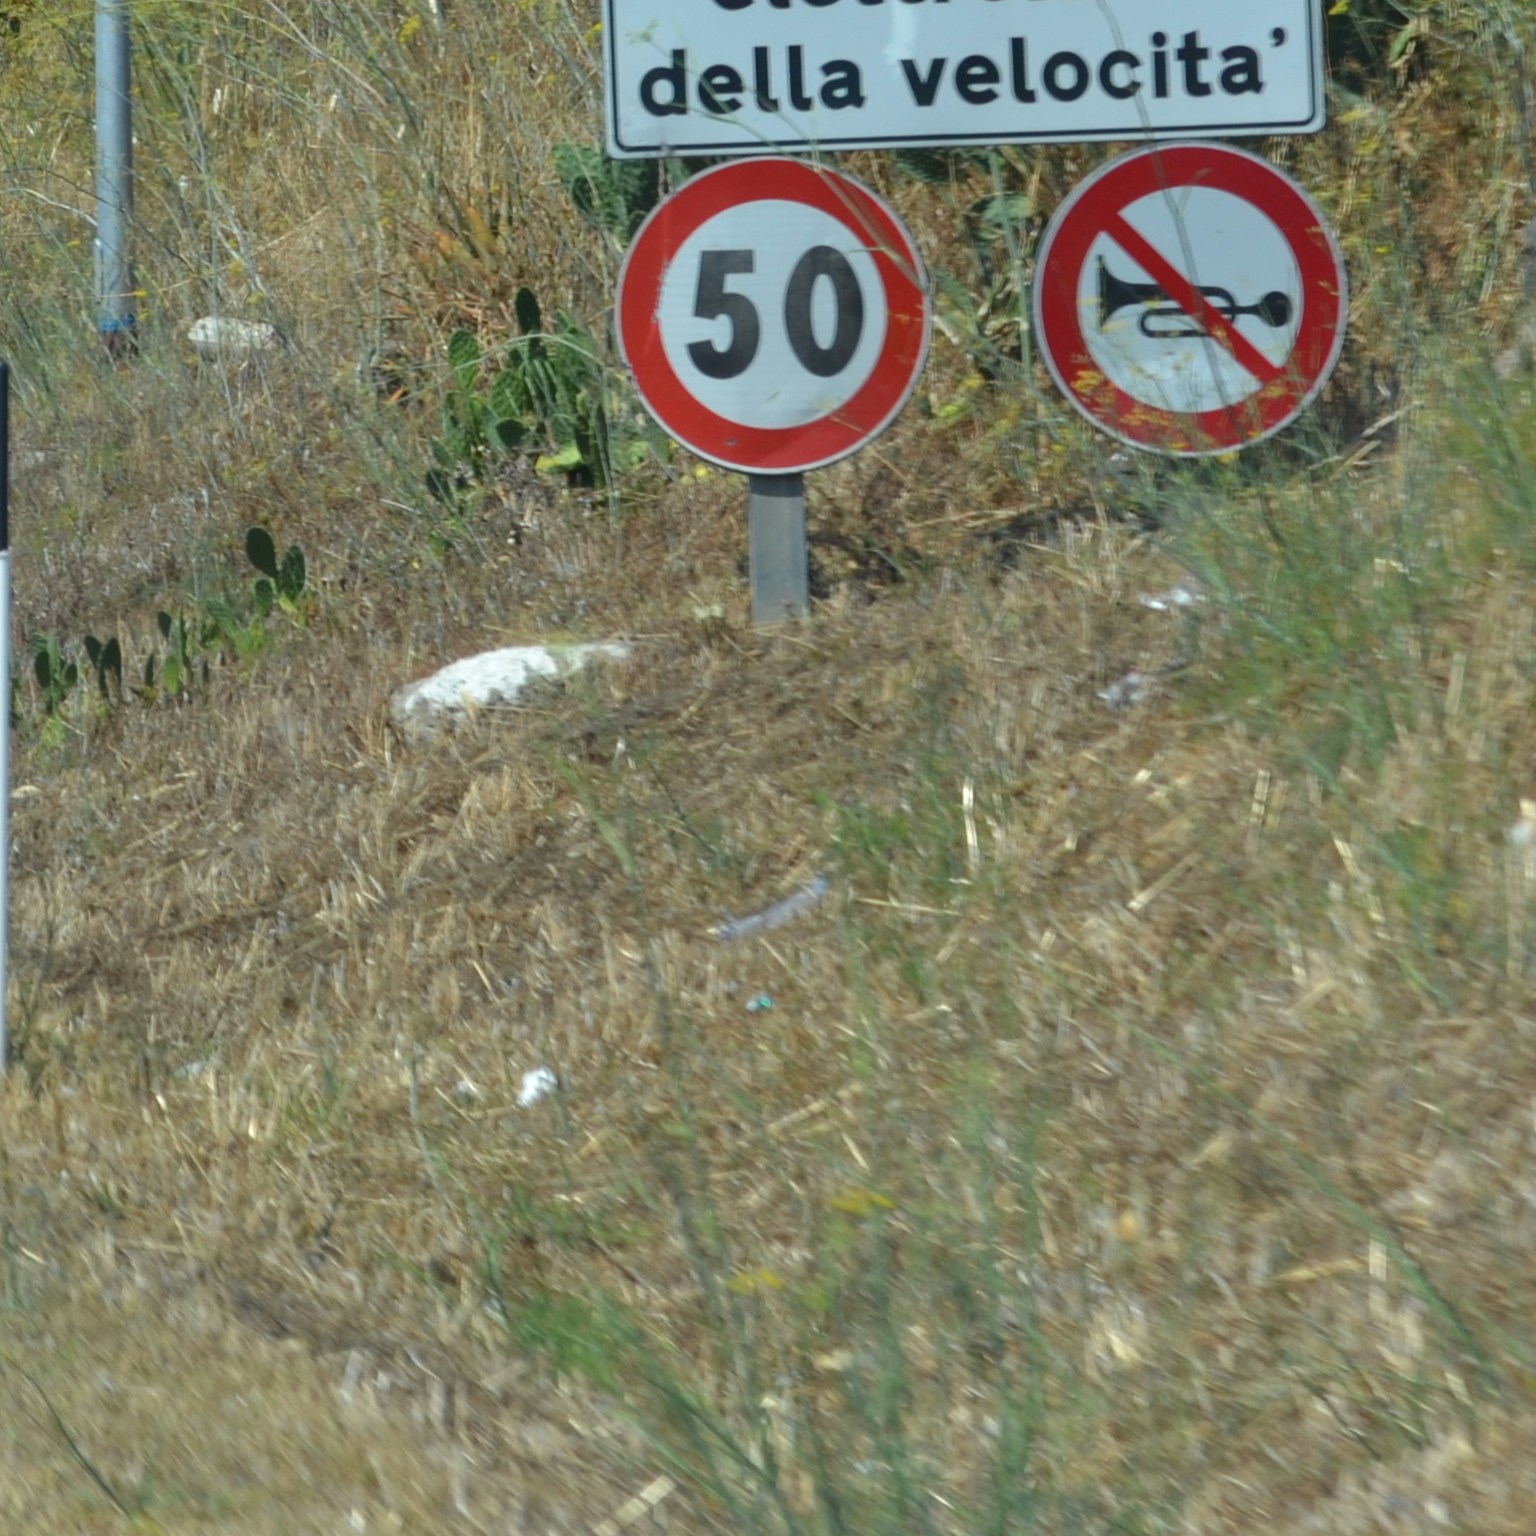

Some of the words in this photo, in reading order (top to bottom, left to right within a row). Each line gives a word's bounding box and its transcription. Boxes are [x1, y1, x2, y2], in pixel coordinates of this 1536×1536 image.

[638, 44, 867, 117] della
[900, 26, 1289, 107] velocita'
[686, 244, 865, 380] 50
